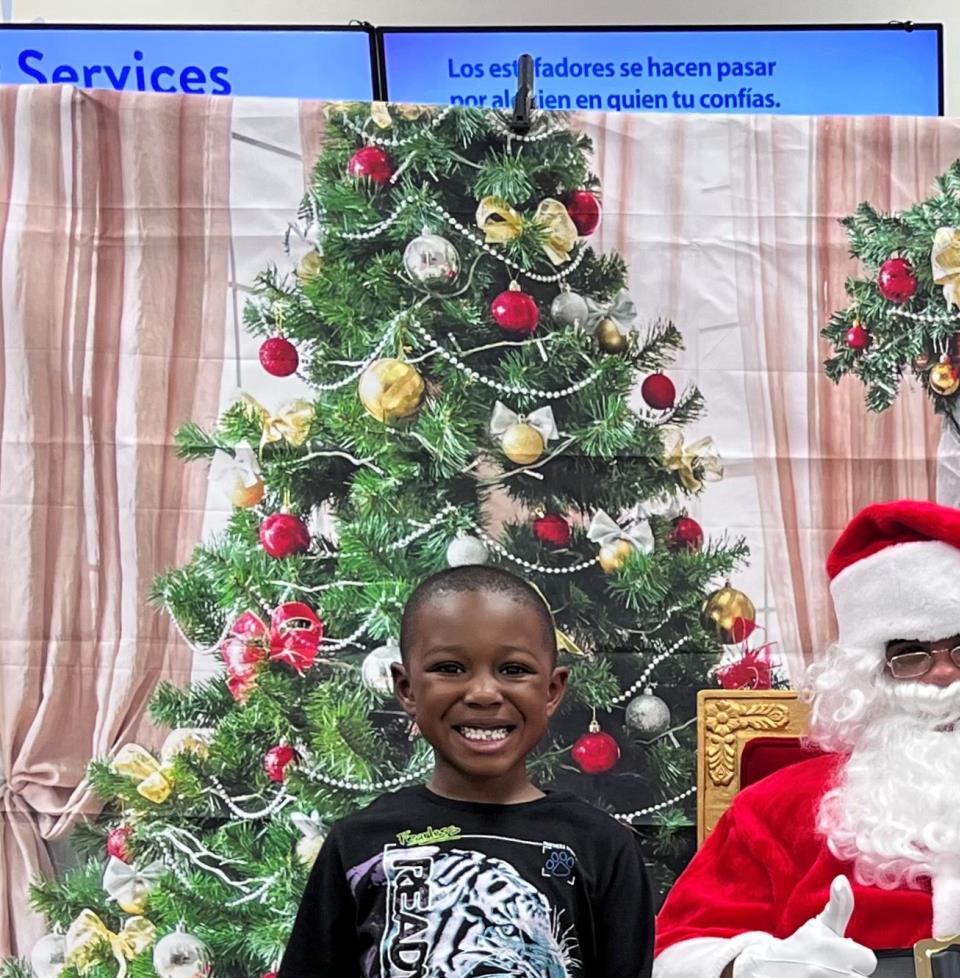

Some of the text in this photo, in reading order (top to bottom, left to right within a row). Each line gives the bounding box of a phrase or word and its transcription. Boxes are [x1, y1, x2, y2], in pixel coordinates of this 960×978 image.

[18, 49, 232, 96] Services
[448, 56, 777, 82] Los estfadores se hacen pasar
[492, 89, 571, 109] alien
[576, 94, 602, 108] en
[607, 88, 668, 112] quien
[672, 91, 695, 108] tu
[700, 87, 781, 108] confías.
